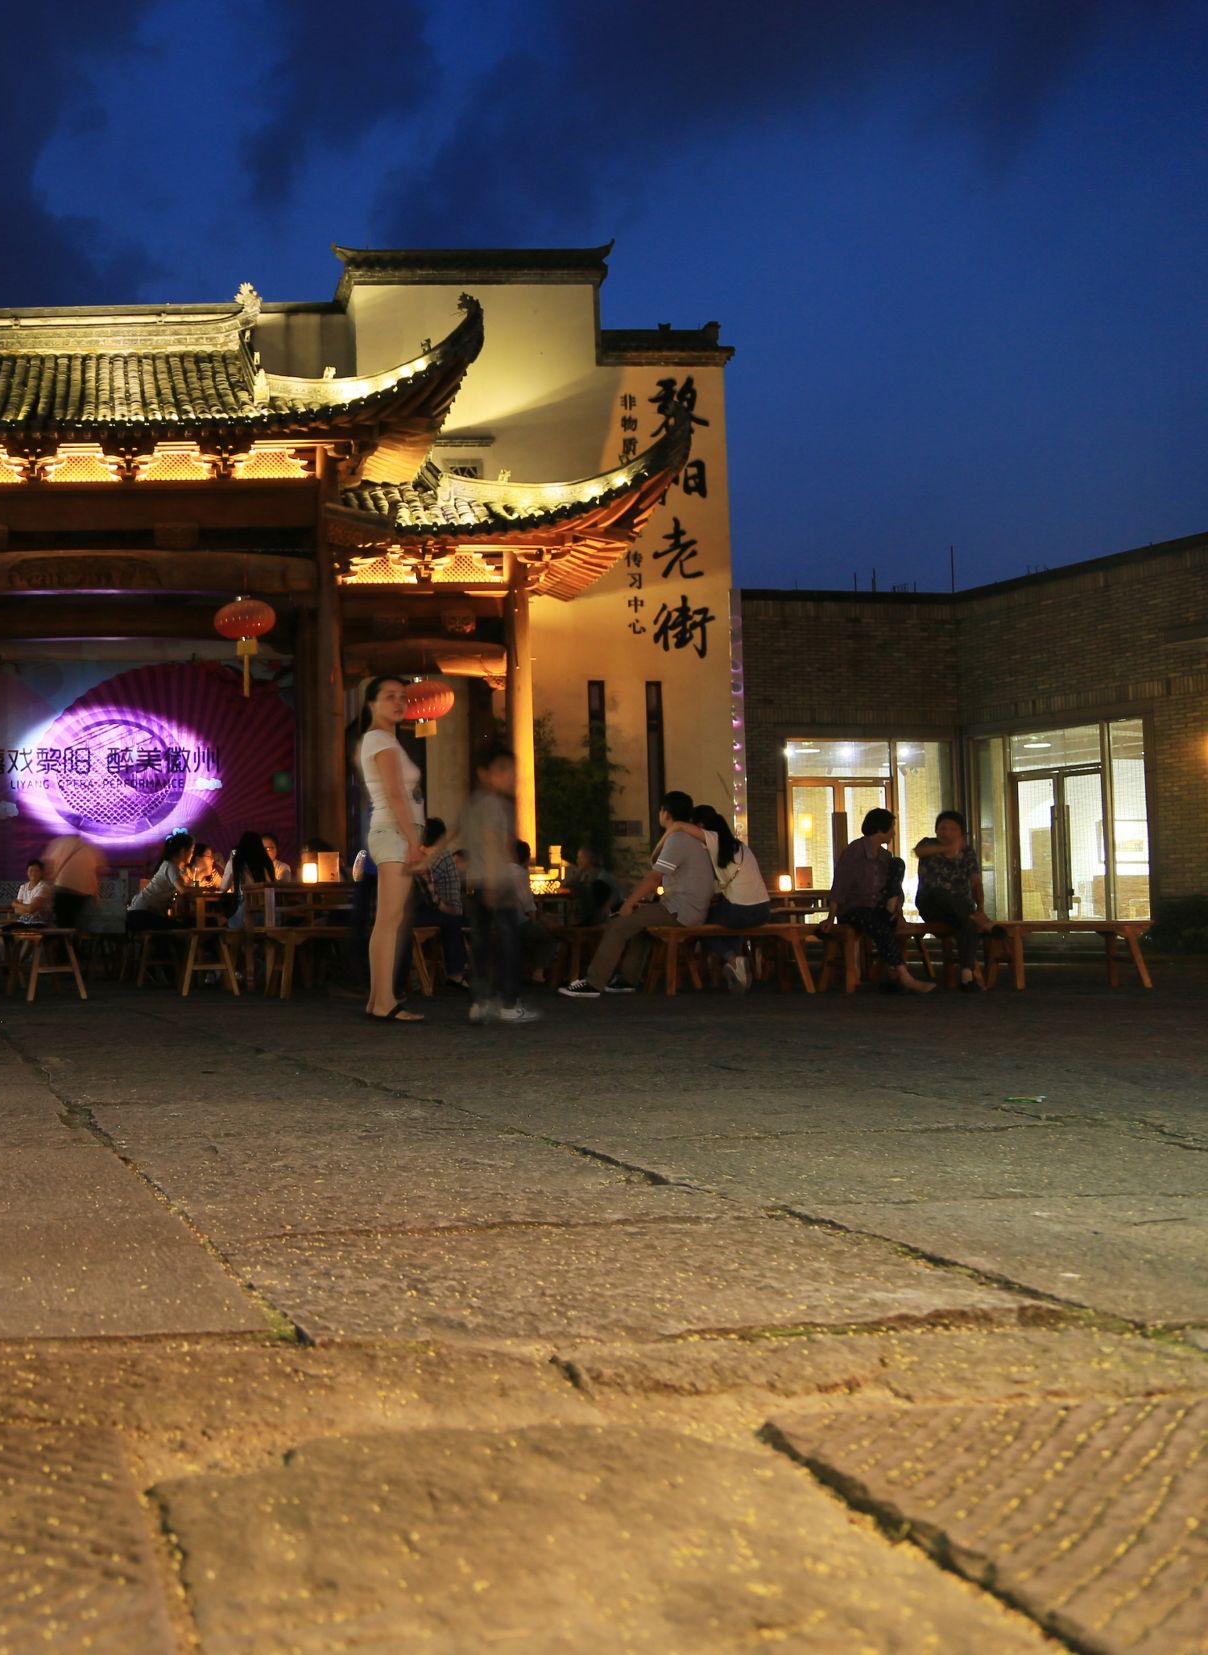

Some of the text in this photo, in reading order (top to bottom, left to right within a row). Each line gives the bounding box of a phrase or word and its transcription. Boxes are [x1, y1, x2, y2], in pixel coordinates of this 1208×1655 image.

[107, 747, 219, 773] 醉美徽州
[11, 780, 49, 789] LIYANG
[103, 779, 184, 789] PERFORMANCE
